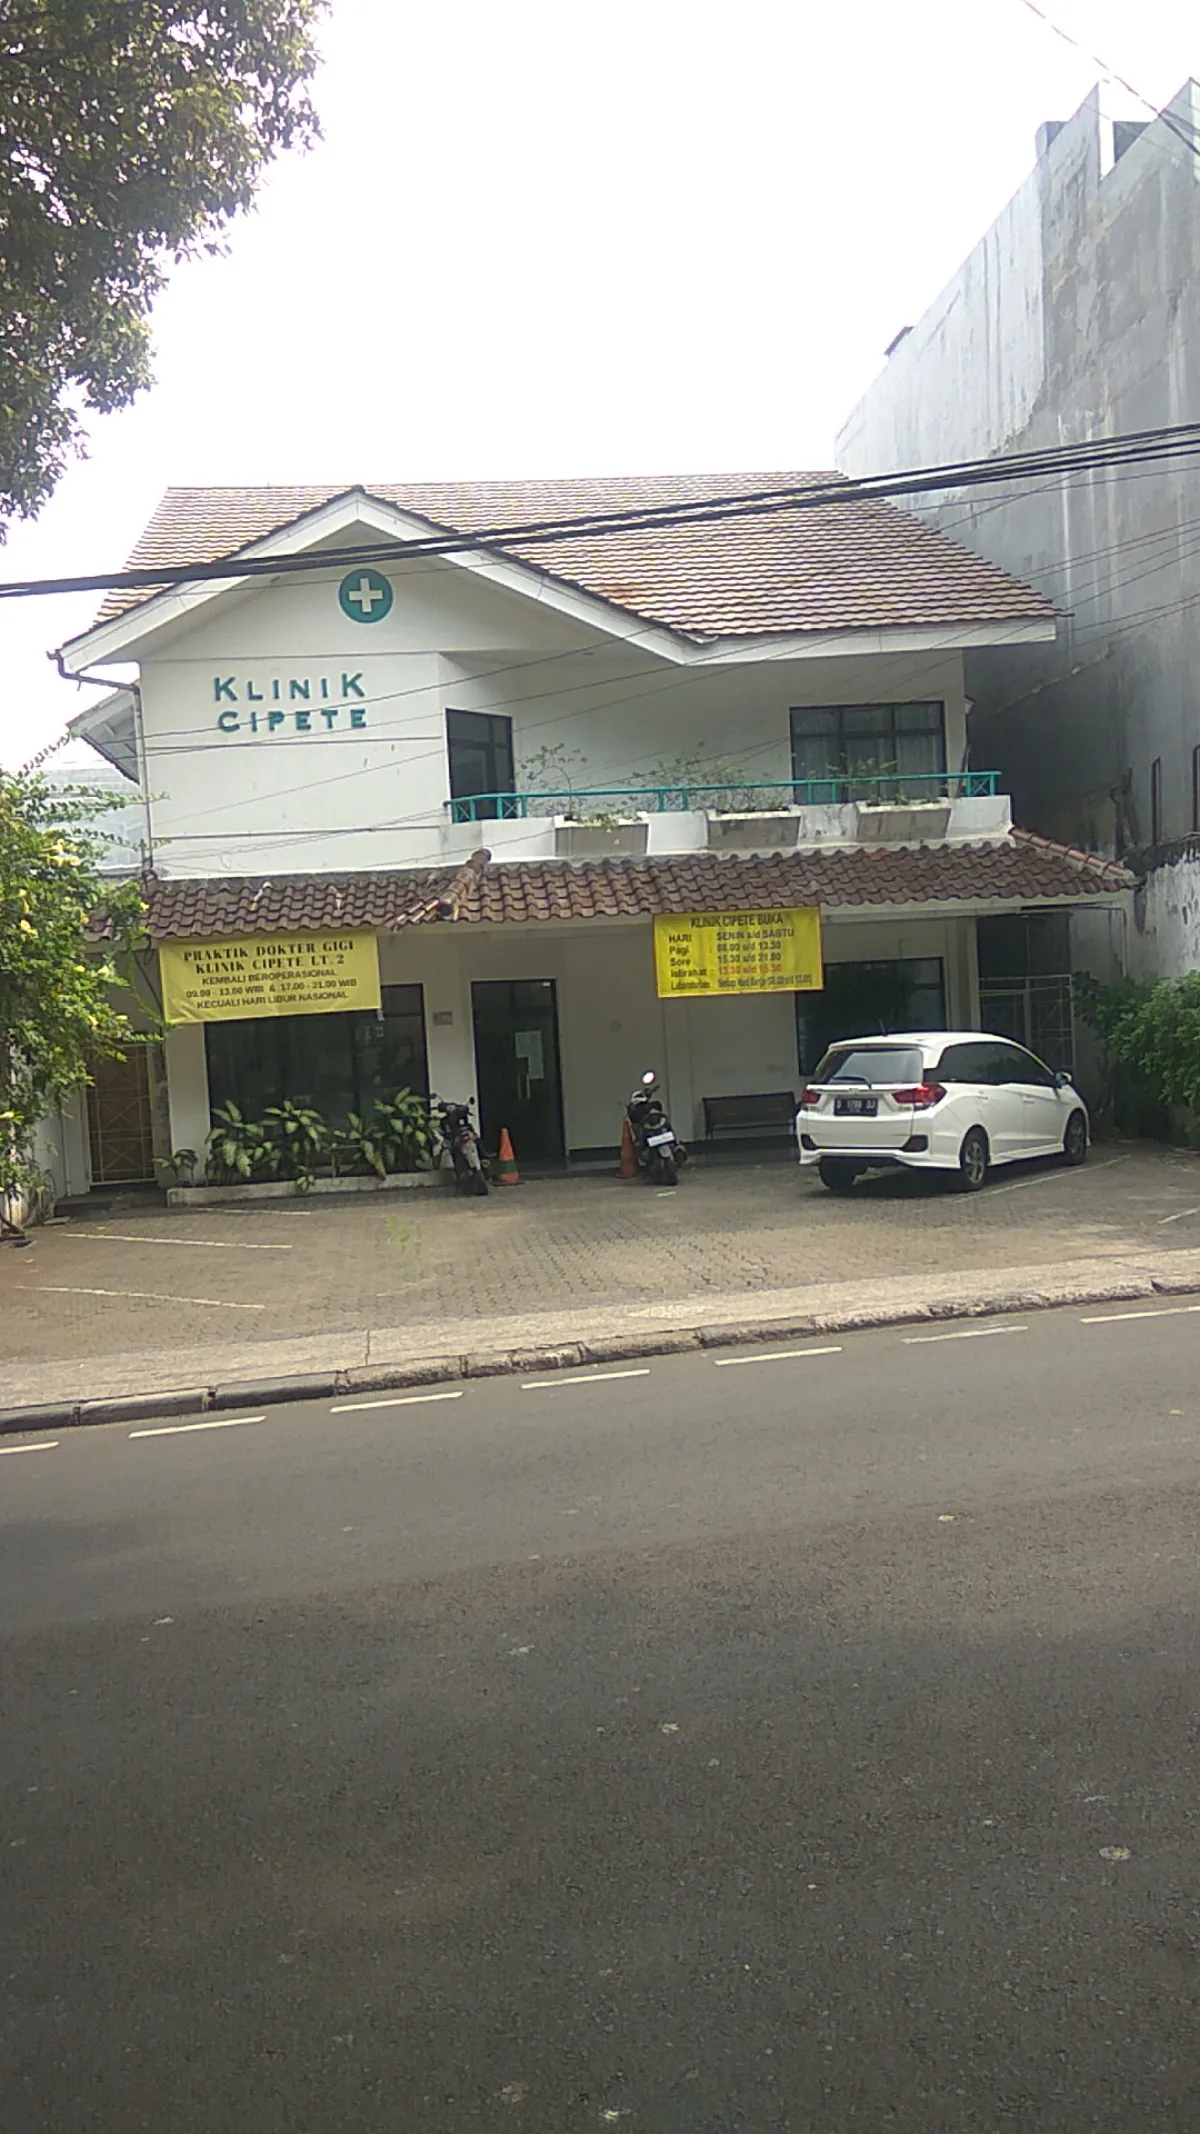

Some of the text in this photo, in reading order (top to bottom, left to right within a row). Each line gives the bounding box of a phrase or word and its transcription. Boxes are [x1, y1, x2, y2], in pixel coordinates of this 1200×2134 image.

[213, 672, 366, 702] KLINIK
[217, 708, 367, 733] CIPETE
[690, 912, 784, 929] KLINIK CIPETE BUKA
[668, 933, 692, 943] HARI
[716, 931, 745, 941] SENIN
[762, 928, 795, 939] SABTU
[183, 940, 354, 962] PRAKTIK DOKTER GIGI
[669, 945, 689, 957] Pagi
[195, 961, 245, 975] KLINIK
[252, 957, 304, 970] CIPETE
[336, 954, 345, 965] 2
[670, 957, 691, 967] Sore
[202, 968, 337, 986] KEMBALI BEROPERASIONAL
[244, 985, 264, 994] WIB
[338, 978, 357, 987] WIB
[197, 998, 240, 1009] KECUALI
[268, 994, 297, 1004] LIBUR
[298, 991, 349, 1001] NASIONAL
